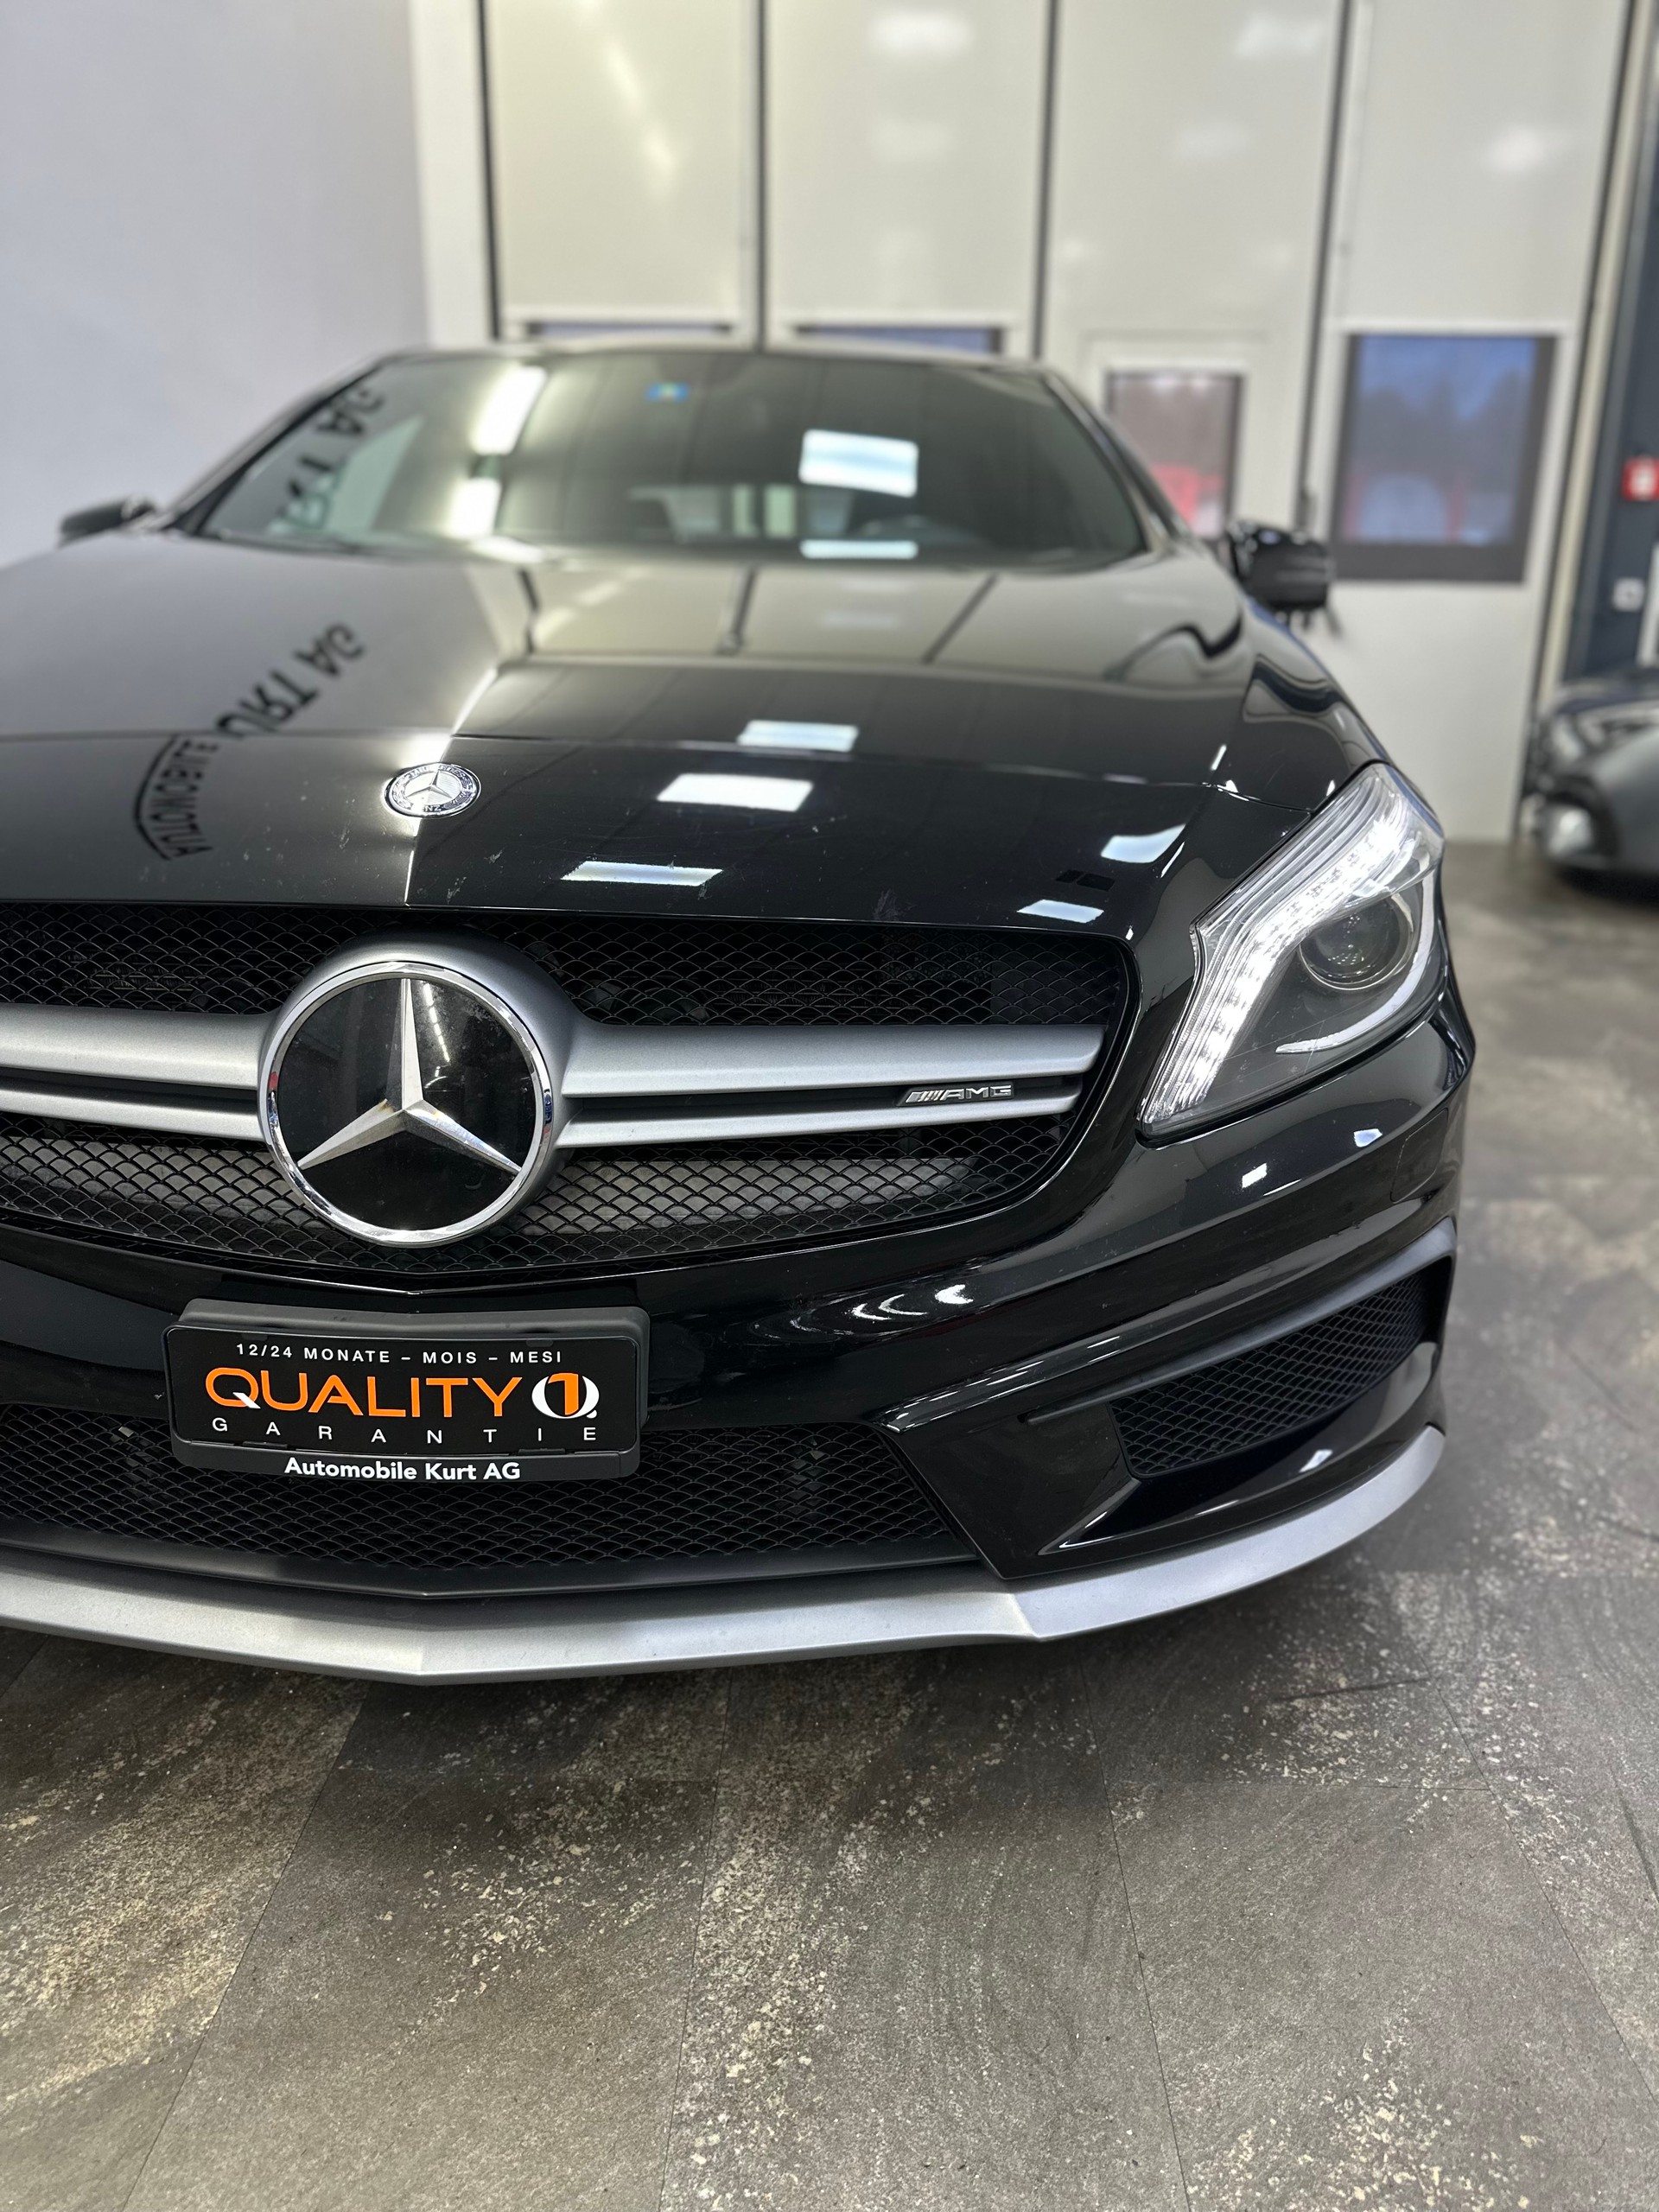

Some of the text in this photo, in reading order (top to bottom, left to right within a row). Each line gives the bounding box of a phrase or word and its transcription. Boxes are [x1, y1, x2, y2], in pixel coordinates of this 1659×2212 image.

[236, 1344, 293, 1358] 12/24
[303, 1347, 390, 1363] MONATE
[423, 1351, 477, 1364] MOIS
[510, 1351, 562, 1363] MESI
[205, 1367, 523, 1418] QUALITY
[212, 1417, 597, 1444] GARANTIE
[284, 1457, 521, 1480] Automobile Kurt AG
